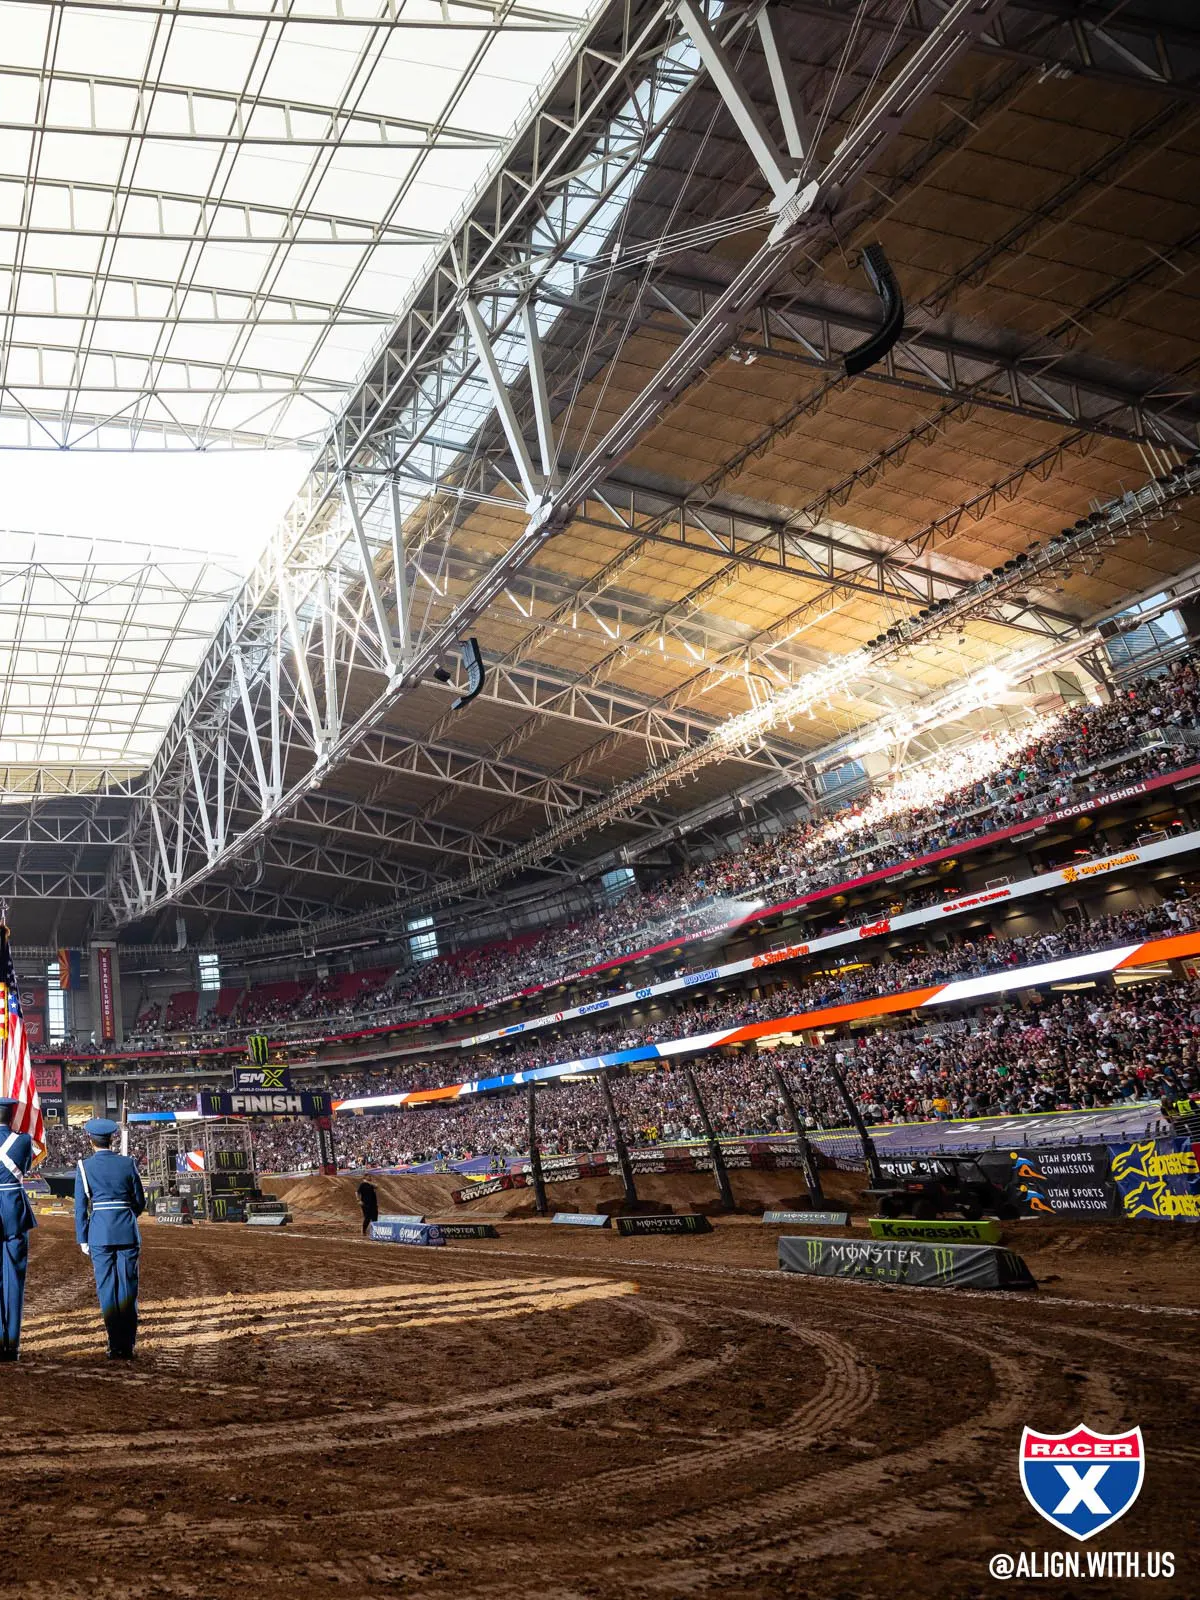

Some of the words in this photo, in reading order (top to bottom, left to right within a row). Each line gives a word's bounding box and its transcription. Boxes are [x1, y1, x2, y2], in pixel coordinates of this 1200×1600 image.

[1056, 801, 1095, 819] ROGER
[1098, 784, 1146, 805] WEHRLI
[692, 931, 703, 939] PAT
[704, 923, 729, 936] TILLMAN
[102, 958, 110, 1015] ESTABLISHED
[635, 988, 652, 999] COX
[239, 1070, 284, 1087] SMX
[231, 1096, 302, 1112] FINISH
[1038, 1155, 1060, 1164] UTAH
[1062, 1153, 1092, 1163] SPORTS
[1041, 1165, 1095, 1174] COMMISSION
[1048, 1188, 1070, 1198] UTAH
[1073, 1188, 1104, 1197] SPORTS
[1050, 1200, 1108, 1209] COMMISSION
[636, 1218, 682, 1227] MONSTER
[882, 1224, 980, 1239] Kawasaki
[831, 1245, 924, 1266] MONSTER
[844, 1265, 910, 1277] ENERGY
